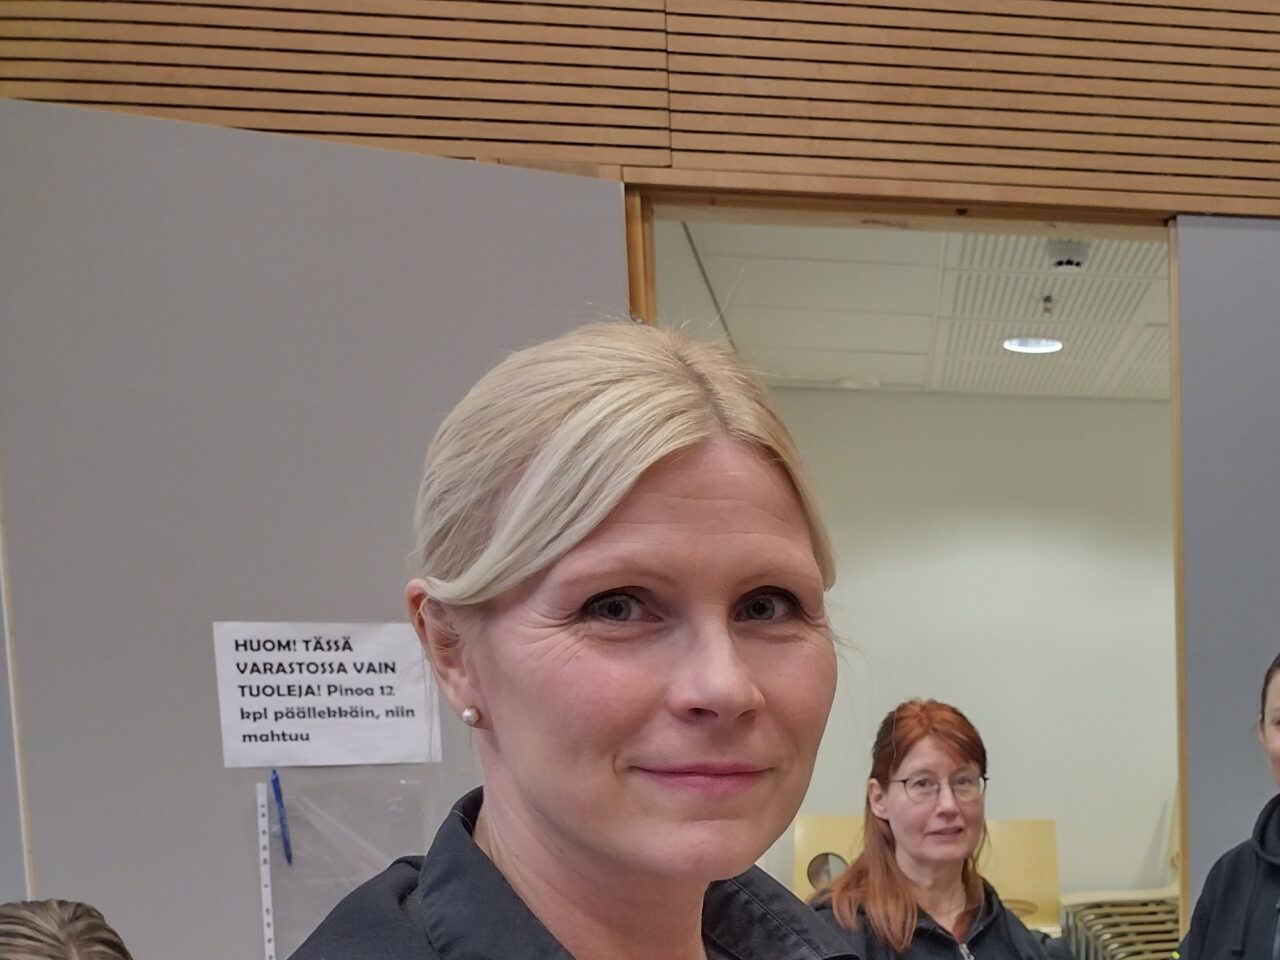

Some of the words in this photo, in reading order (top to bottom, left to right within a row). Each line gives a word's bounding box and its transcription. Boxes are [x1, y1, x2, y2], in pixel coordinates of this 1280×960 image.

[234, 639, 296, 652] HUOM!
[302, 635, 354, 652] TÄSSÄ
[236, 661, 348, 675] VARASTOSSA
[353, 661, 397, 675] VAIN
[238, 684, 322, 698] TUOLEJA!
[326, 684, 375, 697] Pinoa
[380, 685, 396, 697] 12
[240, 707, 268, 723] kpl
[274, 706, 381, 723] päällekkäin,
[385, 705, 416, 718] niin
[242, 729, 310, 743] mahtuu
